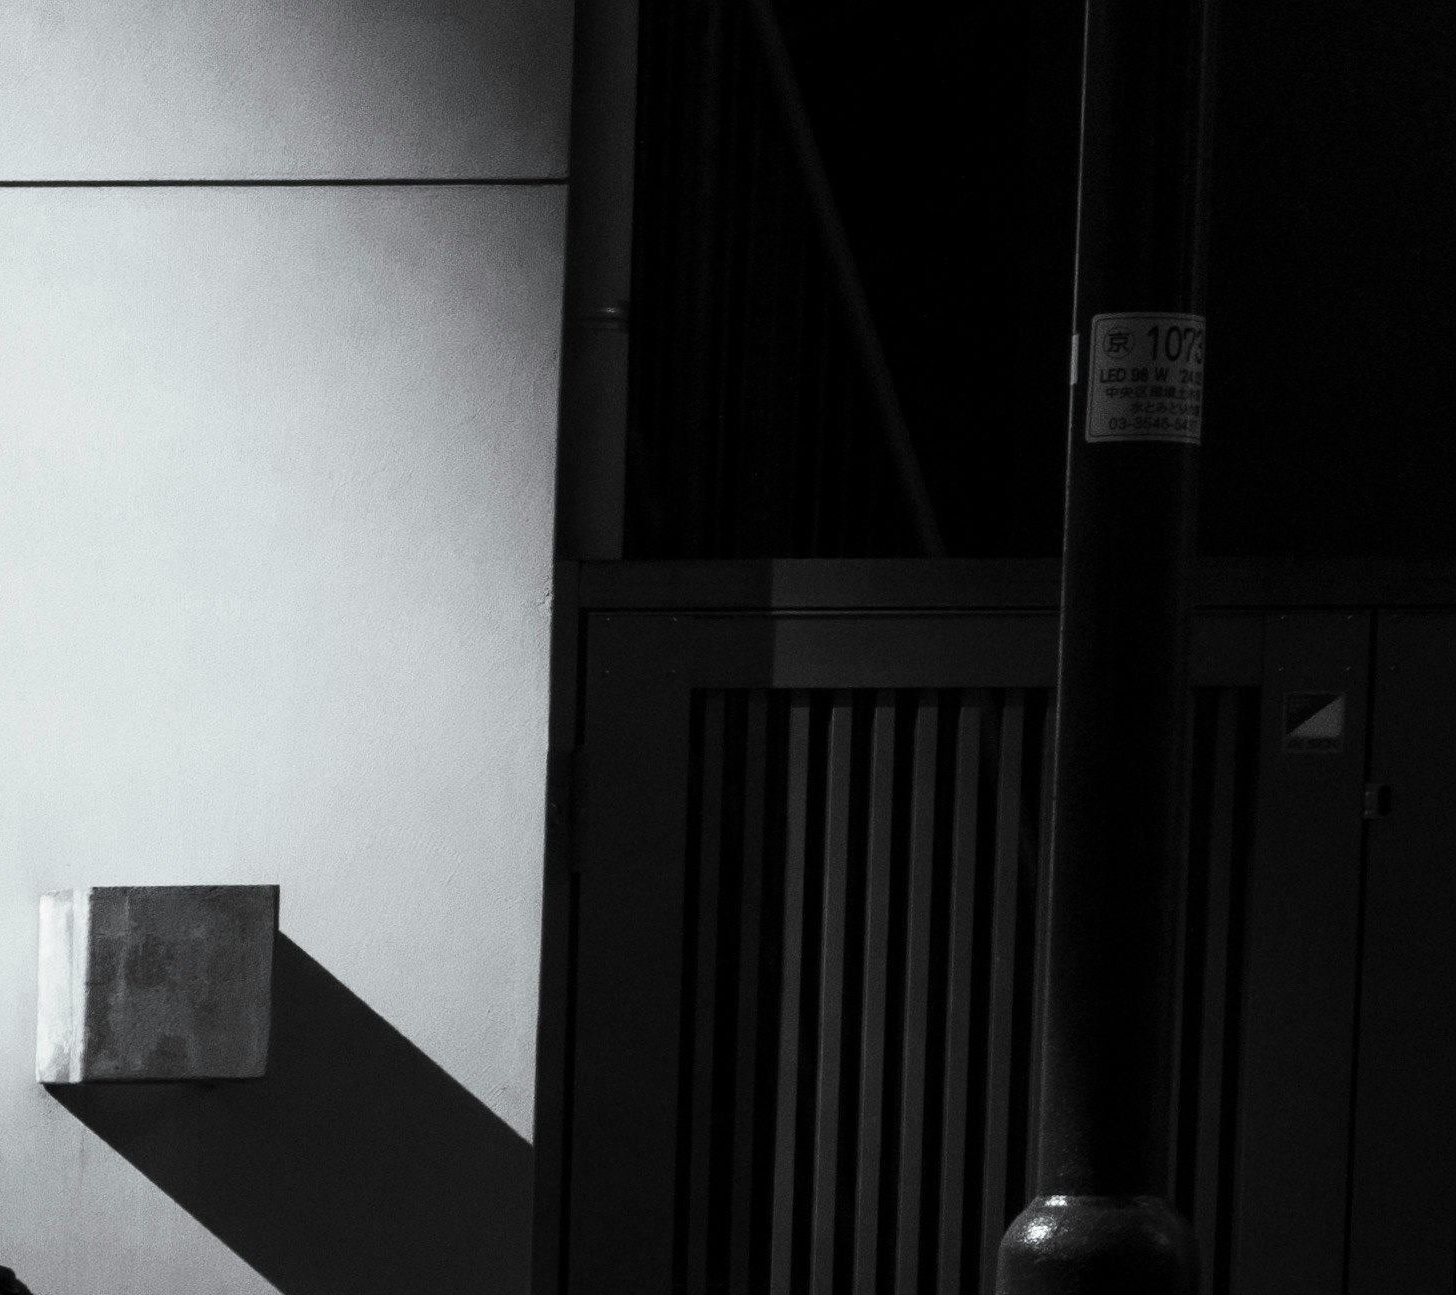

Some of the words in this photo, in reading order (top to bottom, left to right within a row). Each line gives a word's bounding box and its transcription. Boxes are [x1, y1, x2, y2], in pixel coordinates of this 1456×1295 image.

[1105, 330, 1132, 355] 京
[1100, 368, 1127, 383] LED
[1154, 367, 1170, 383] W
